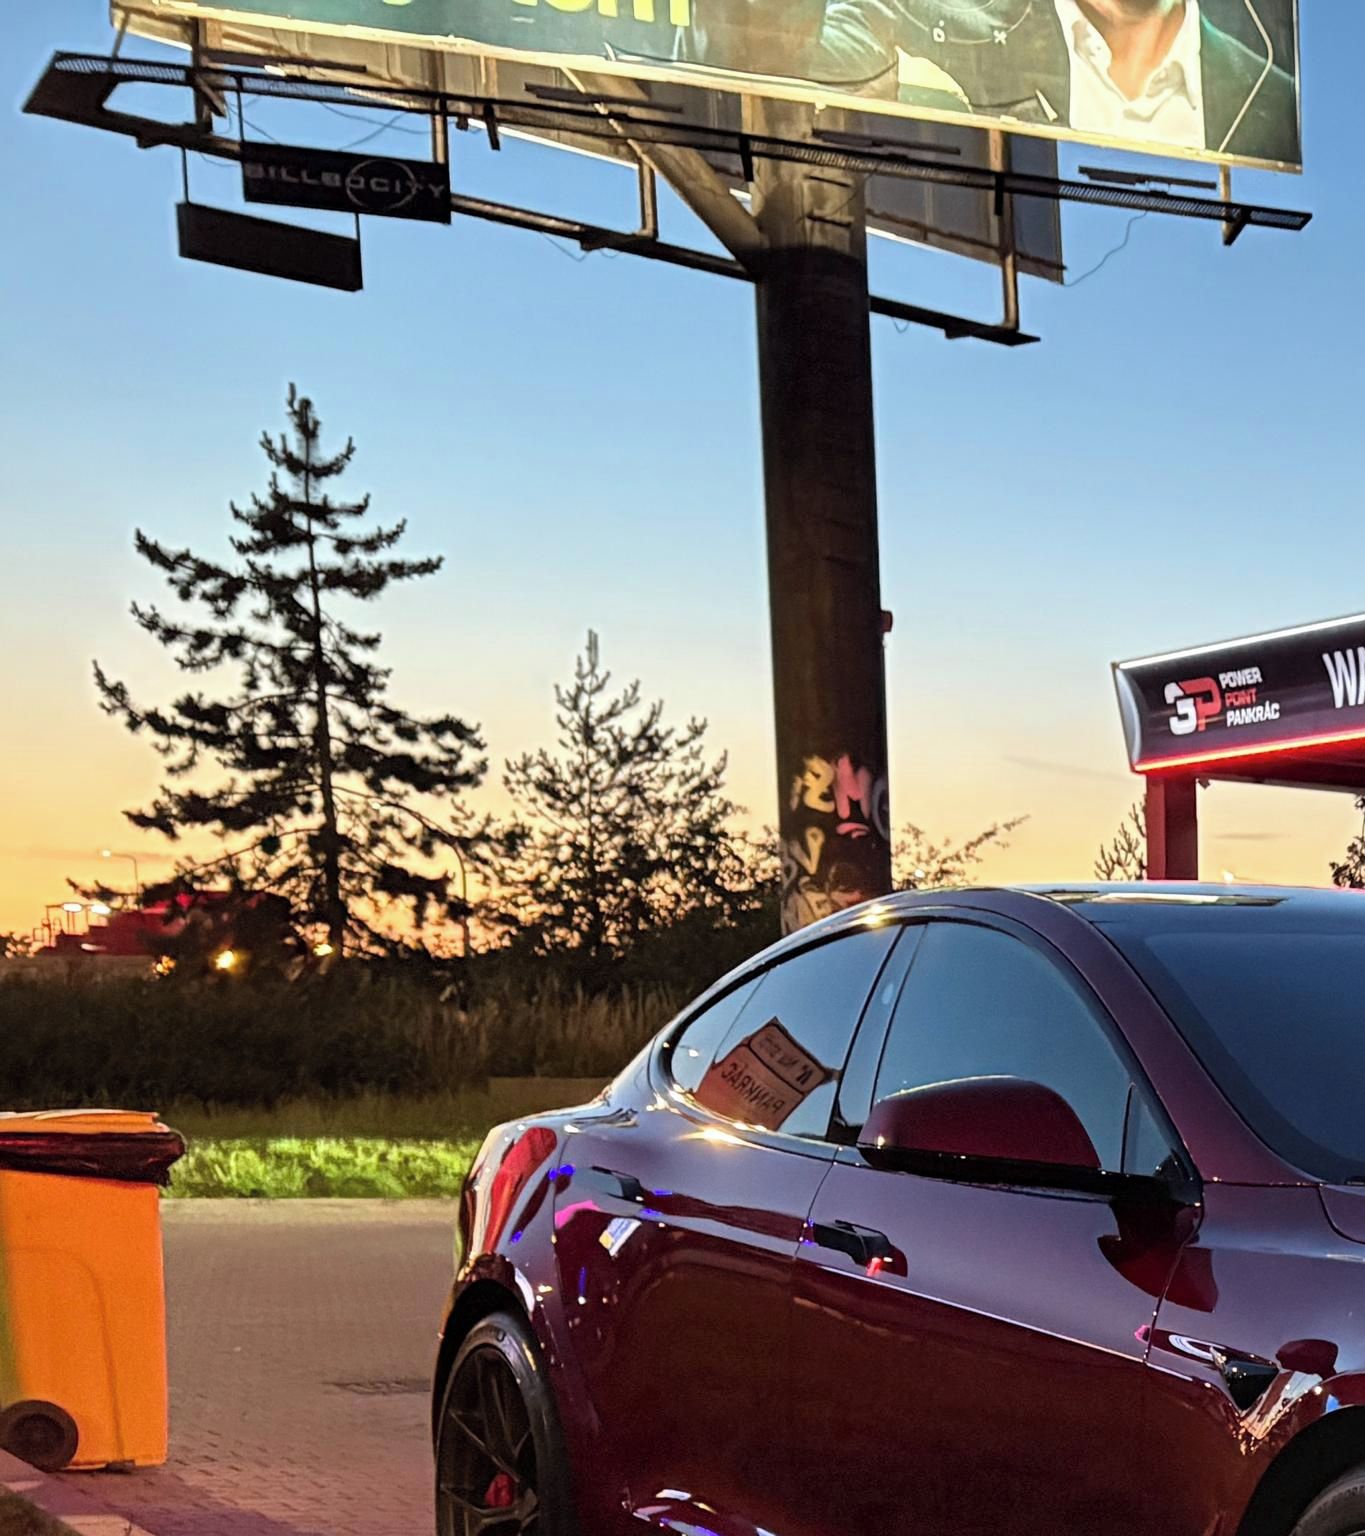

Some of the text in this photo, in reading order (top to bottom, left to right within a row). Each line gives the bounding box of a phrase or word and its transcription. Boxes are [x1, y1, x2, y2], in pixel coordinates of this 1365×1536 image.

[1219, 667, 1262, 689] POWER
[1225, 689, 1259, 708] POINT
[1226, 700, 1279, 726] PANKRÁC
